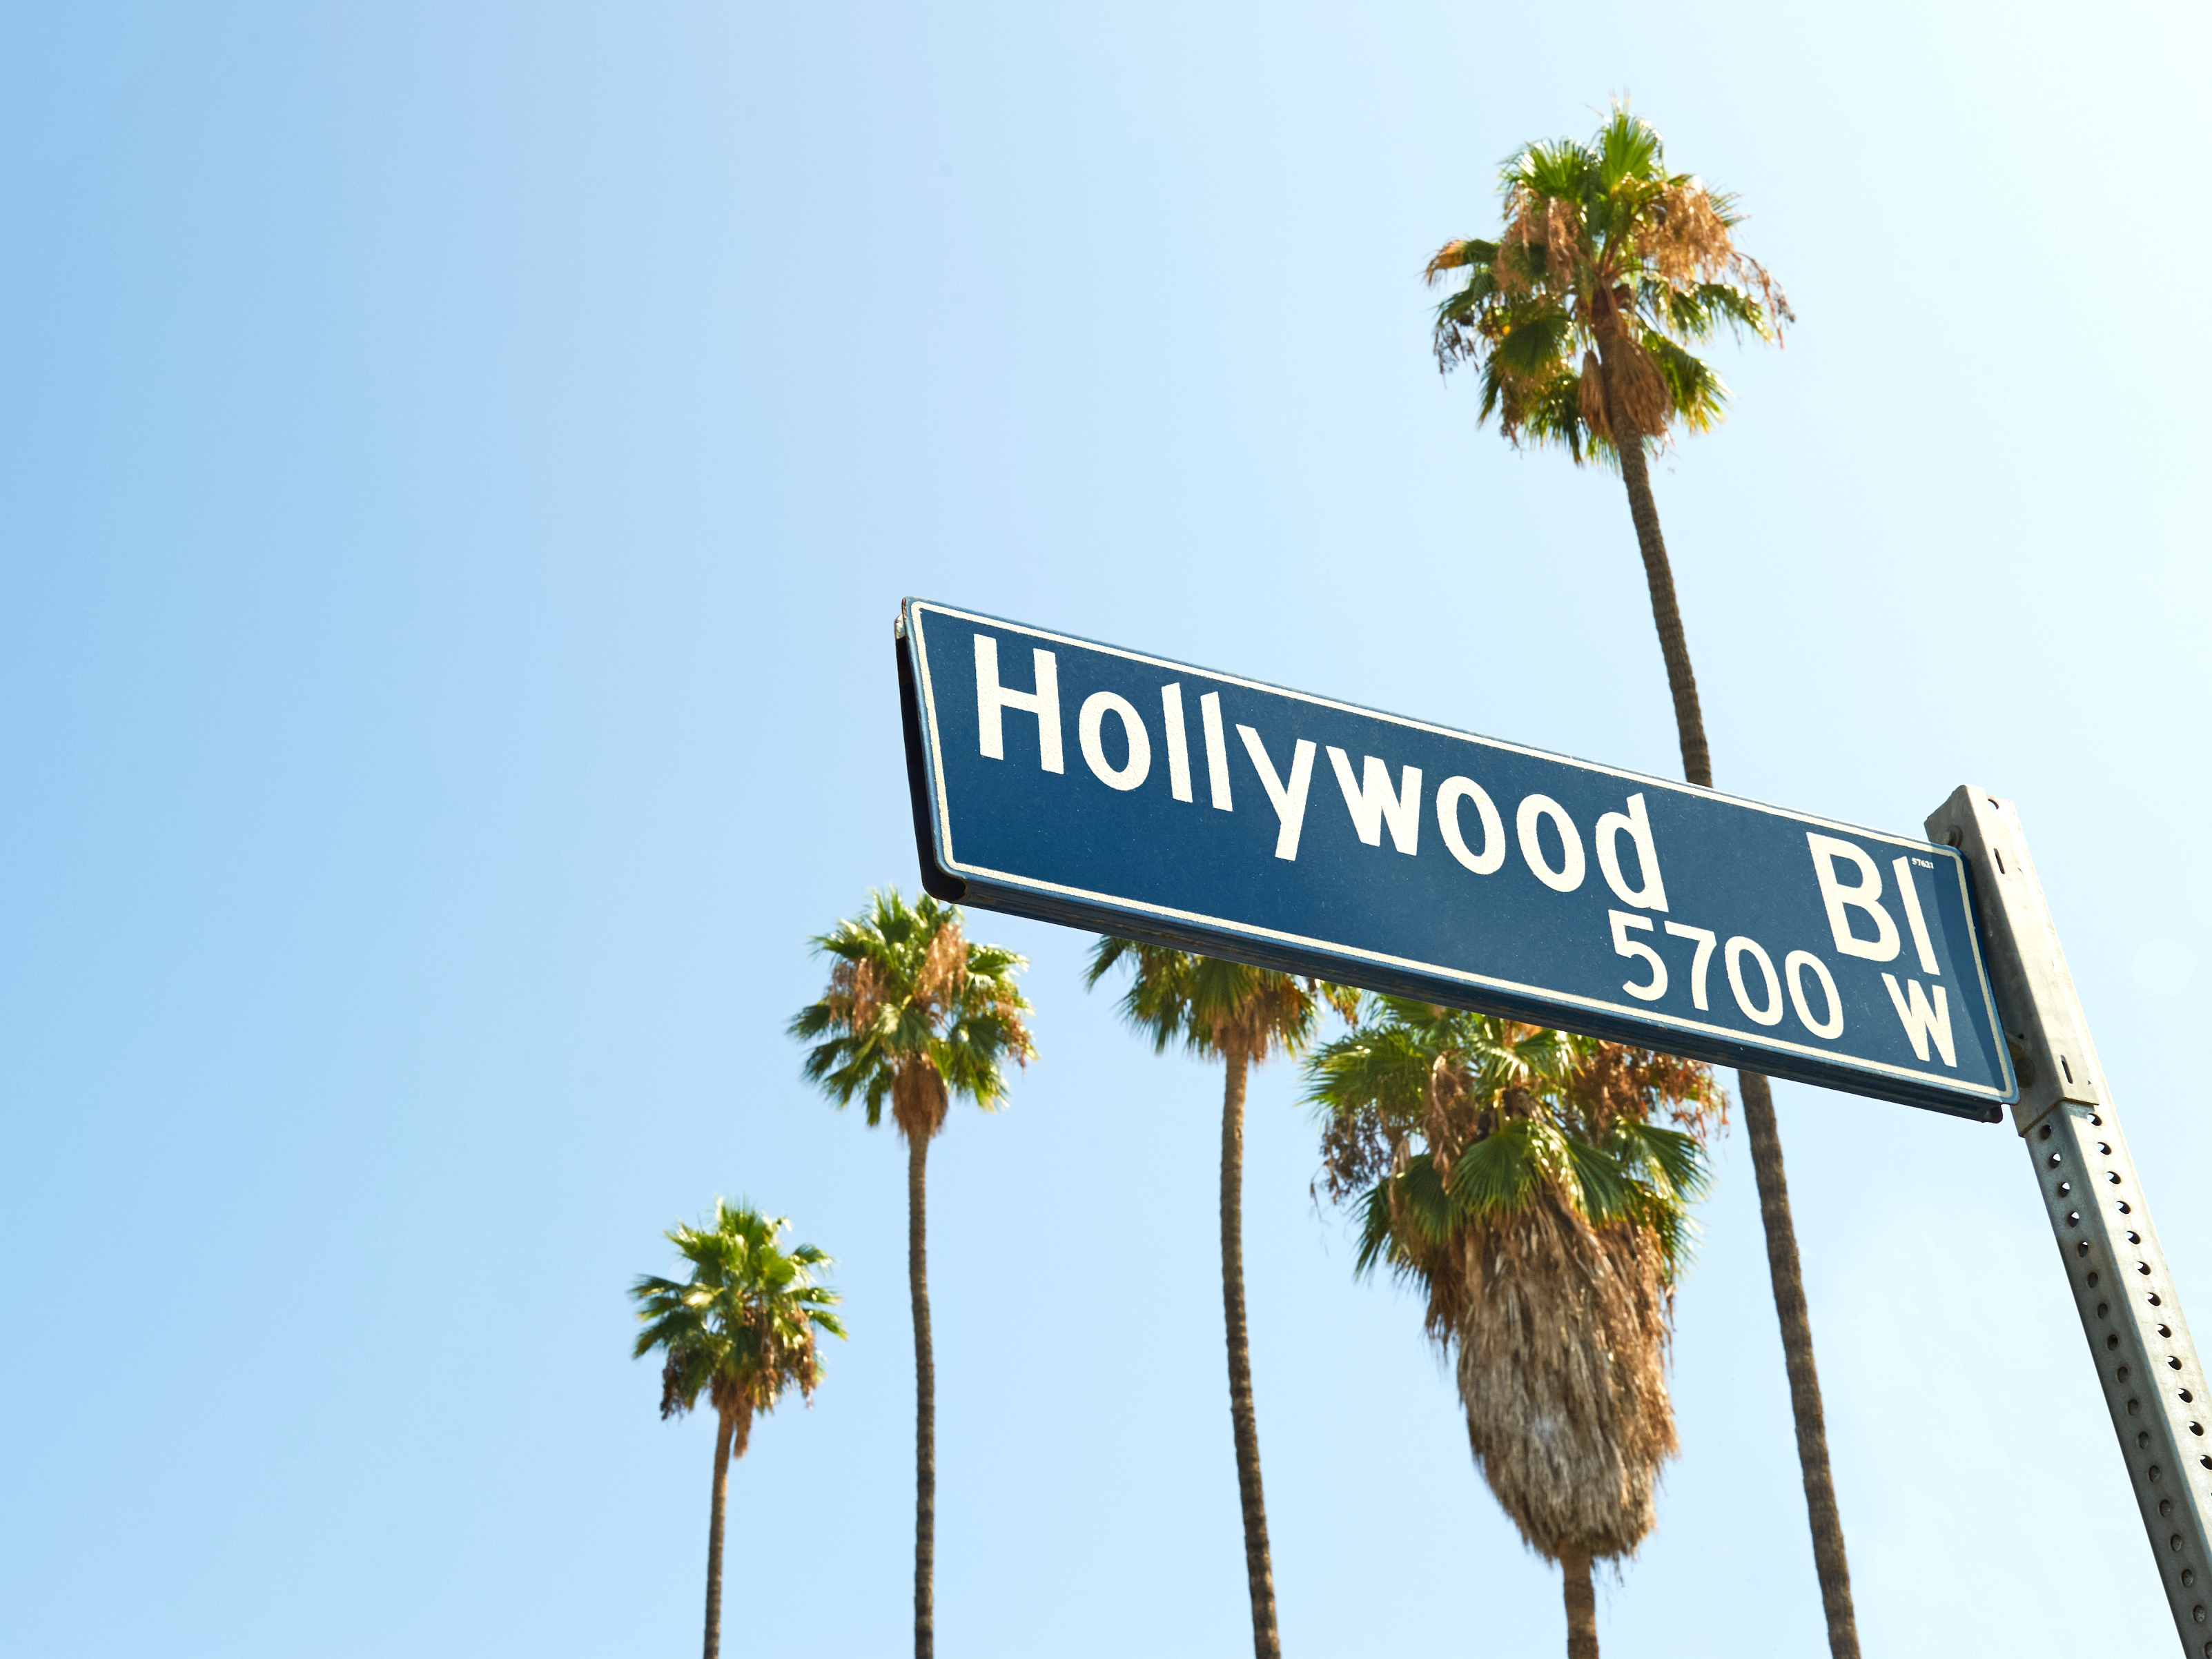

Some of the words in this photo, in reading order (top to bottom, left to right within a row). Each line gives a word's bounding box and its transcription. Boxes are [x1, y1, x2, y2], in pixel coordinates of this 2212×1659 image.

[974, 634, 1670, 913] Hollywood
[1806, 832, 1941, 976] Bl
[1608, 909, 1844, 1040] 5700
[1881, 972, 1957, 1068] W
